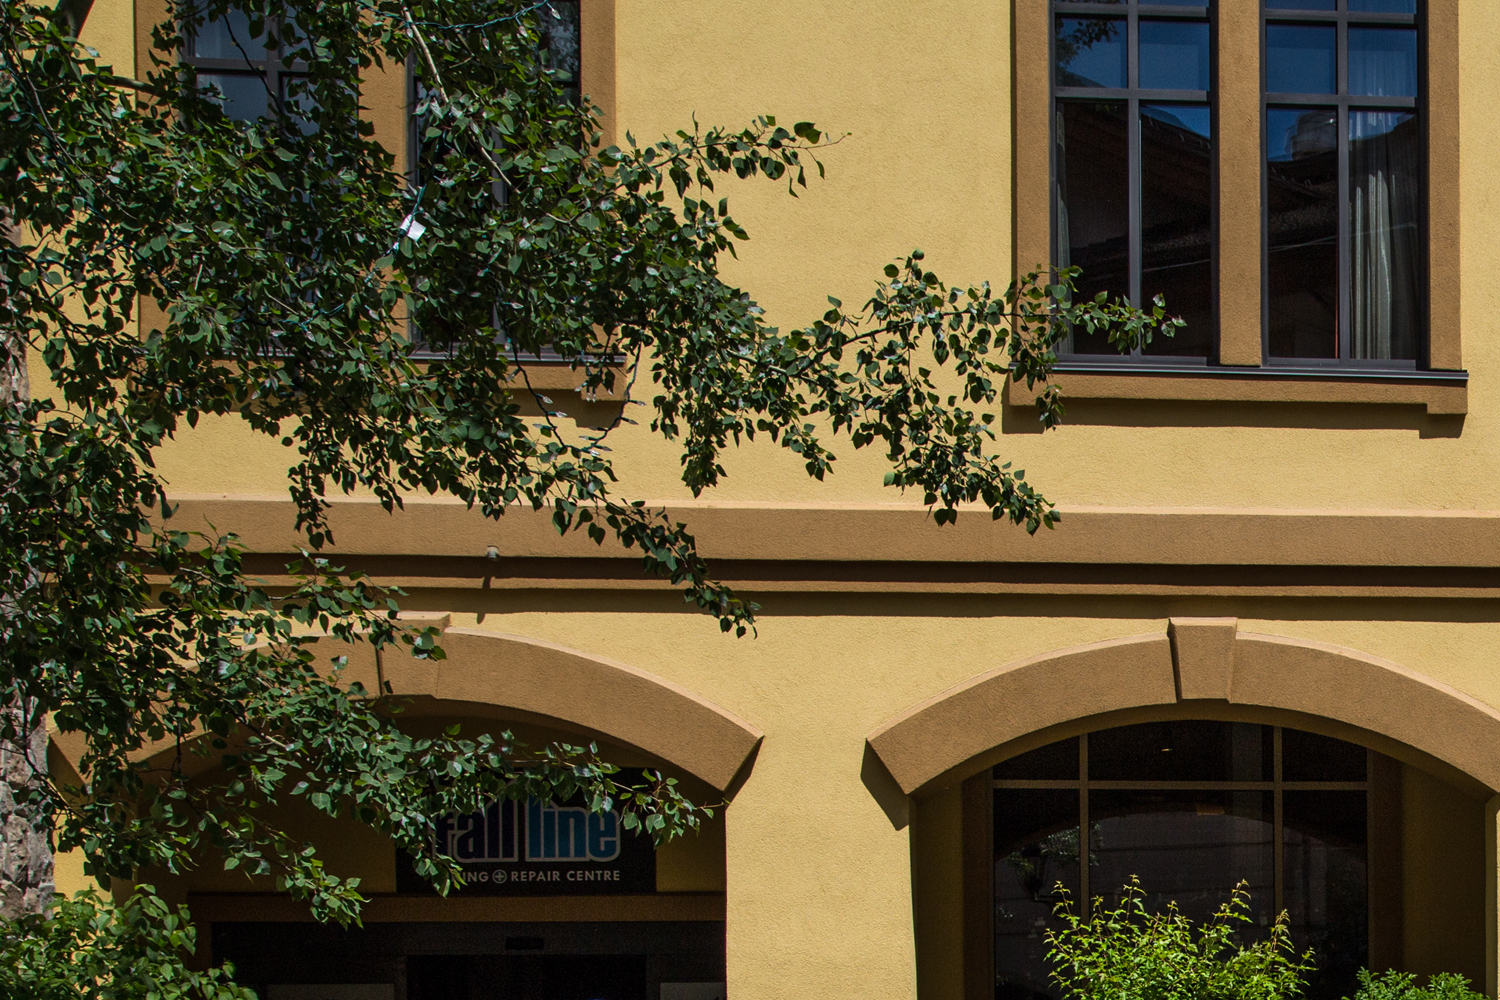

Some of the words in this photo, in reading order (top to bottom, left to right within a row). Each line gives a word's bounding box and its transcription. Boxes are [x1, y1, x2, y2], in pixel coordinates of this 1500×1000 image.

[432, 788, 518, 862] fall
[525, 788, 620, 861] line
[511, 871, 561, 882] REPAIR
[566, 870, 621, 881] CENTRE
